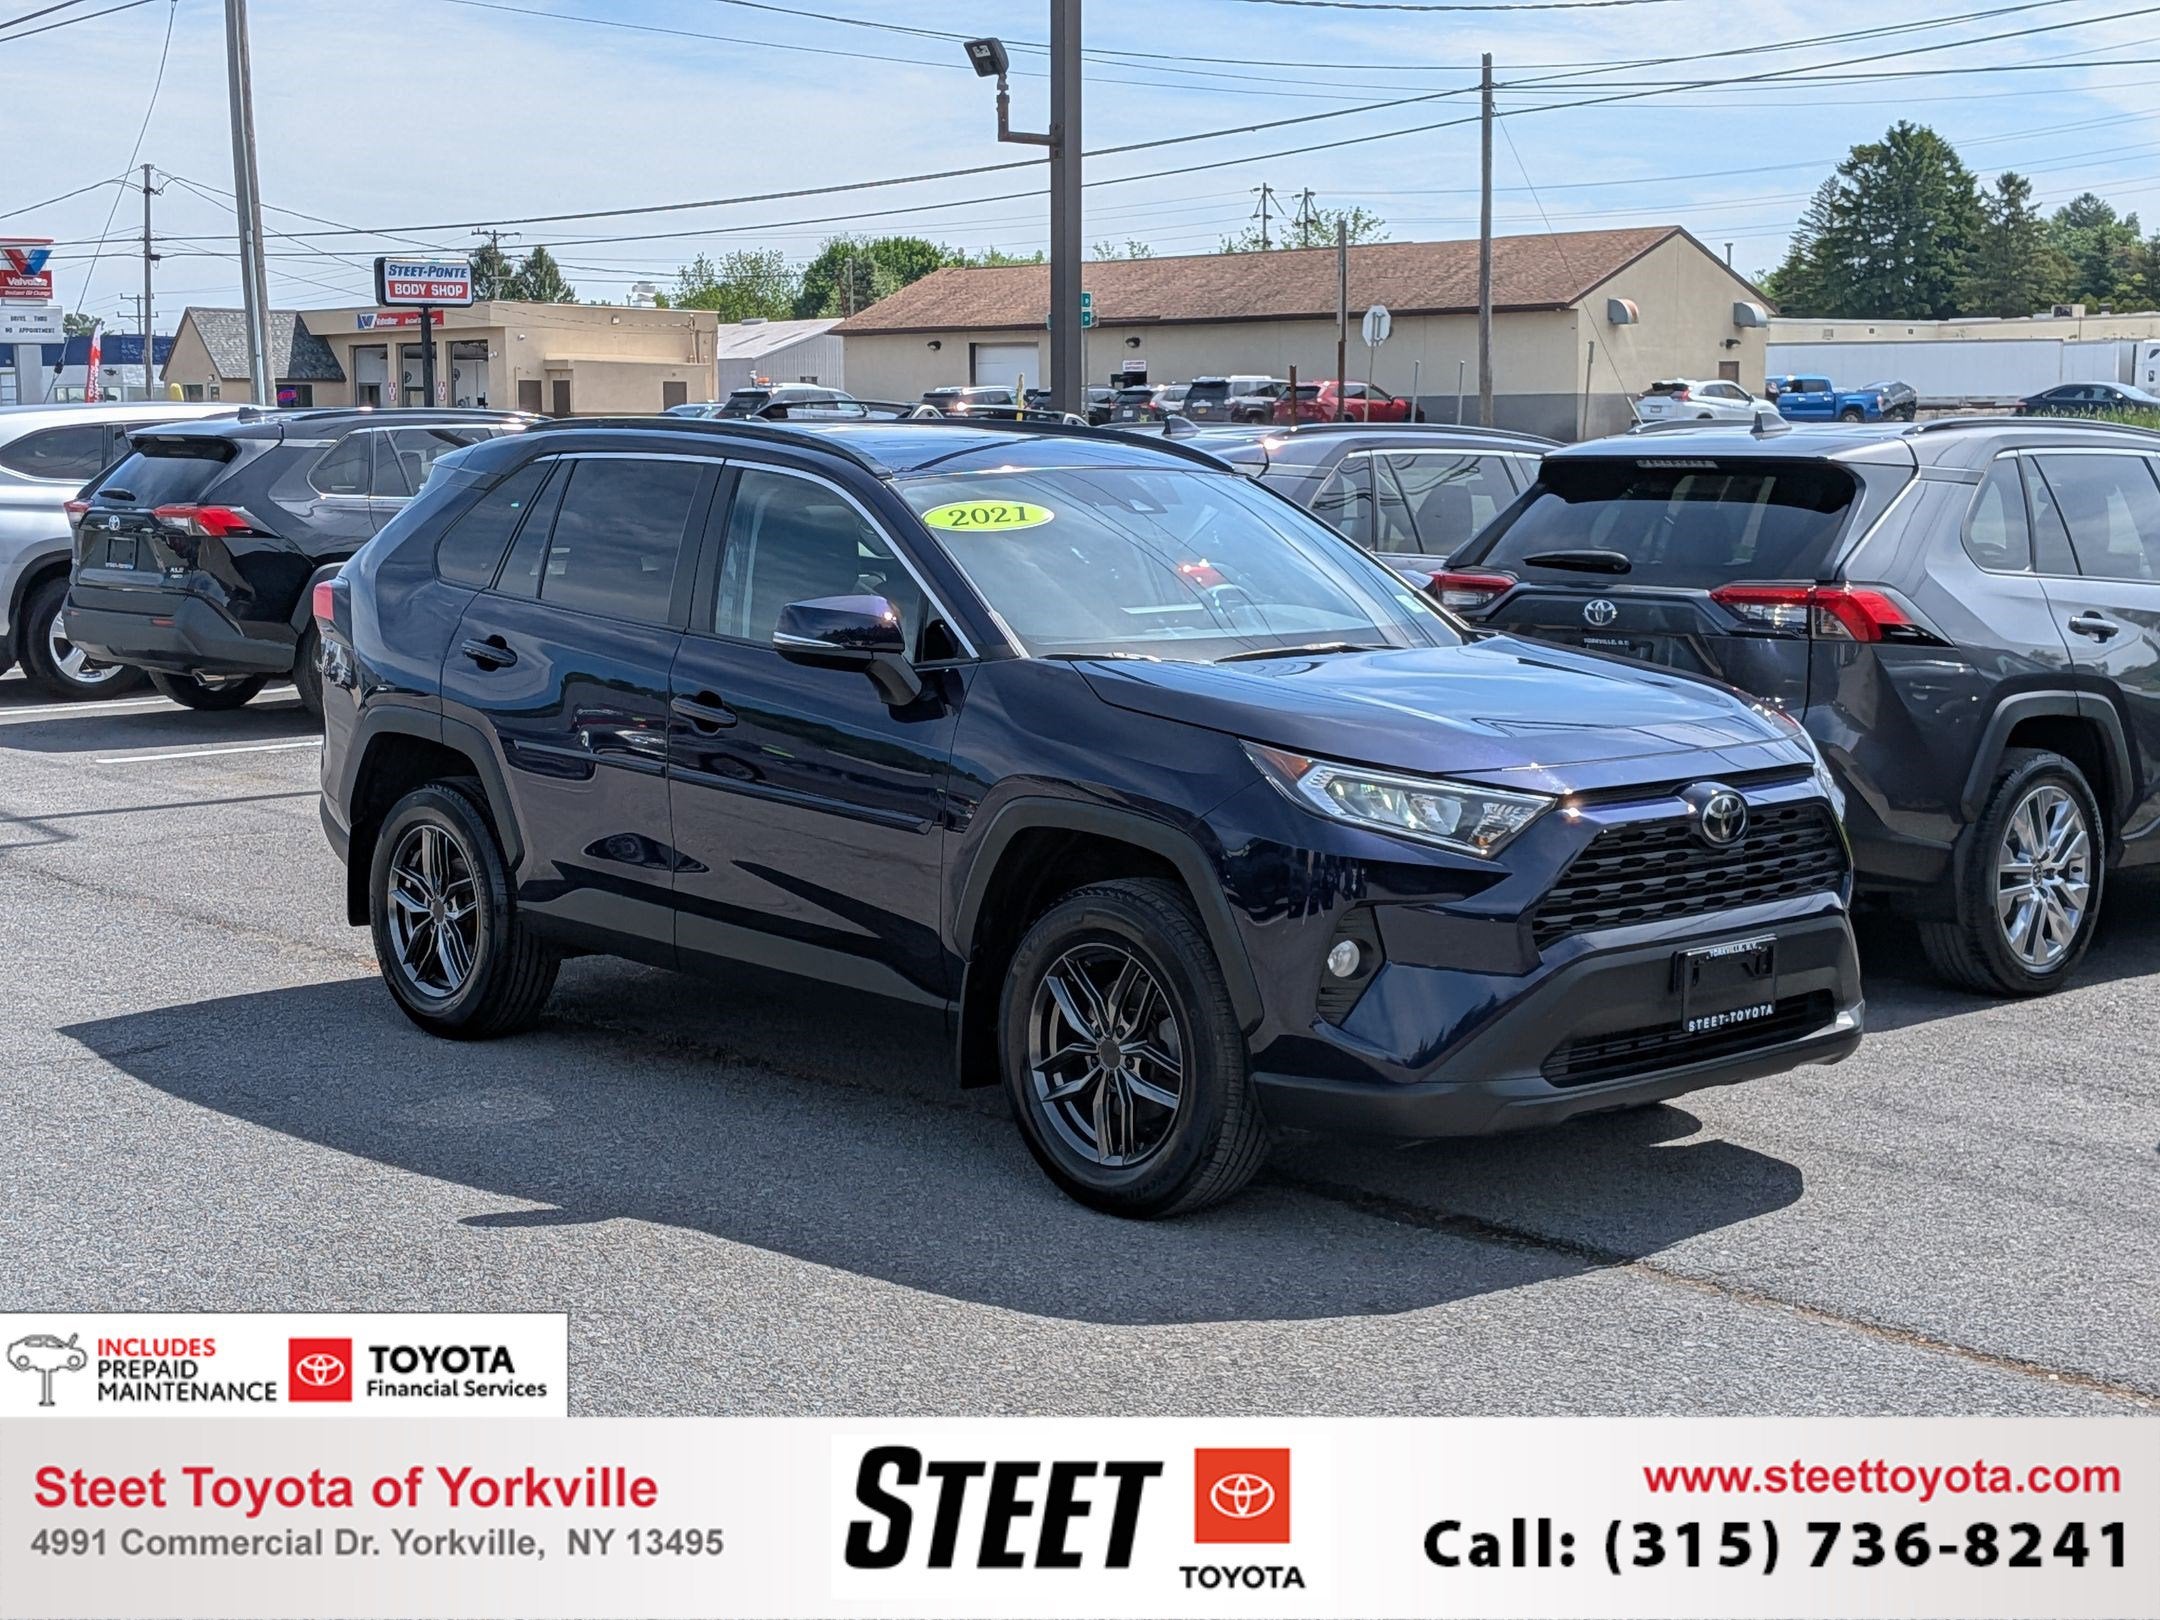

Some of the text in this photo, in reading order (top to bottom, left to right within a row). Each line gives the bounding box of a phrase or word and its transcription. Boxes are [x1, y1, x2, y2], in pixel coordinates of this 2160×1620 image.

[388, 264, 468, 279] STEET-PONTE
[394, 283, 464, 297] BODY SHOP
[948, 506, 1030, 527] 2021
